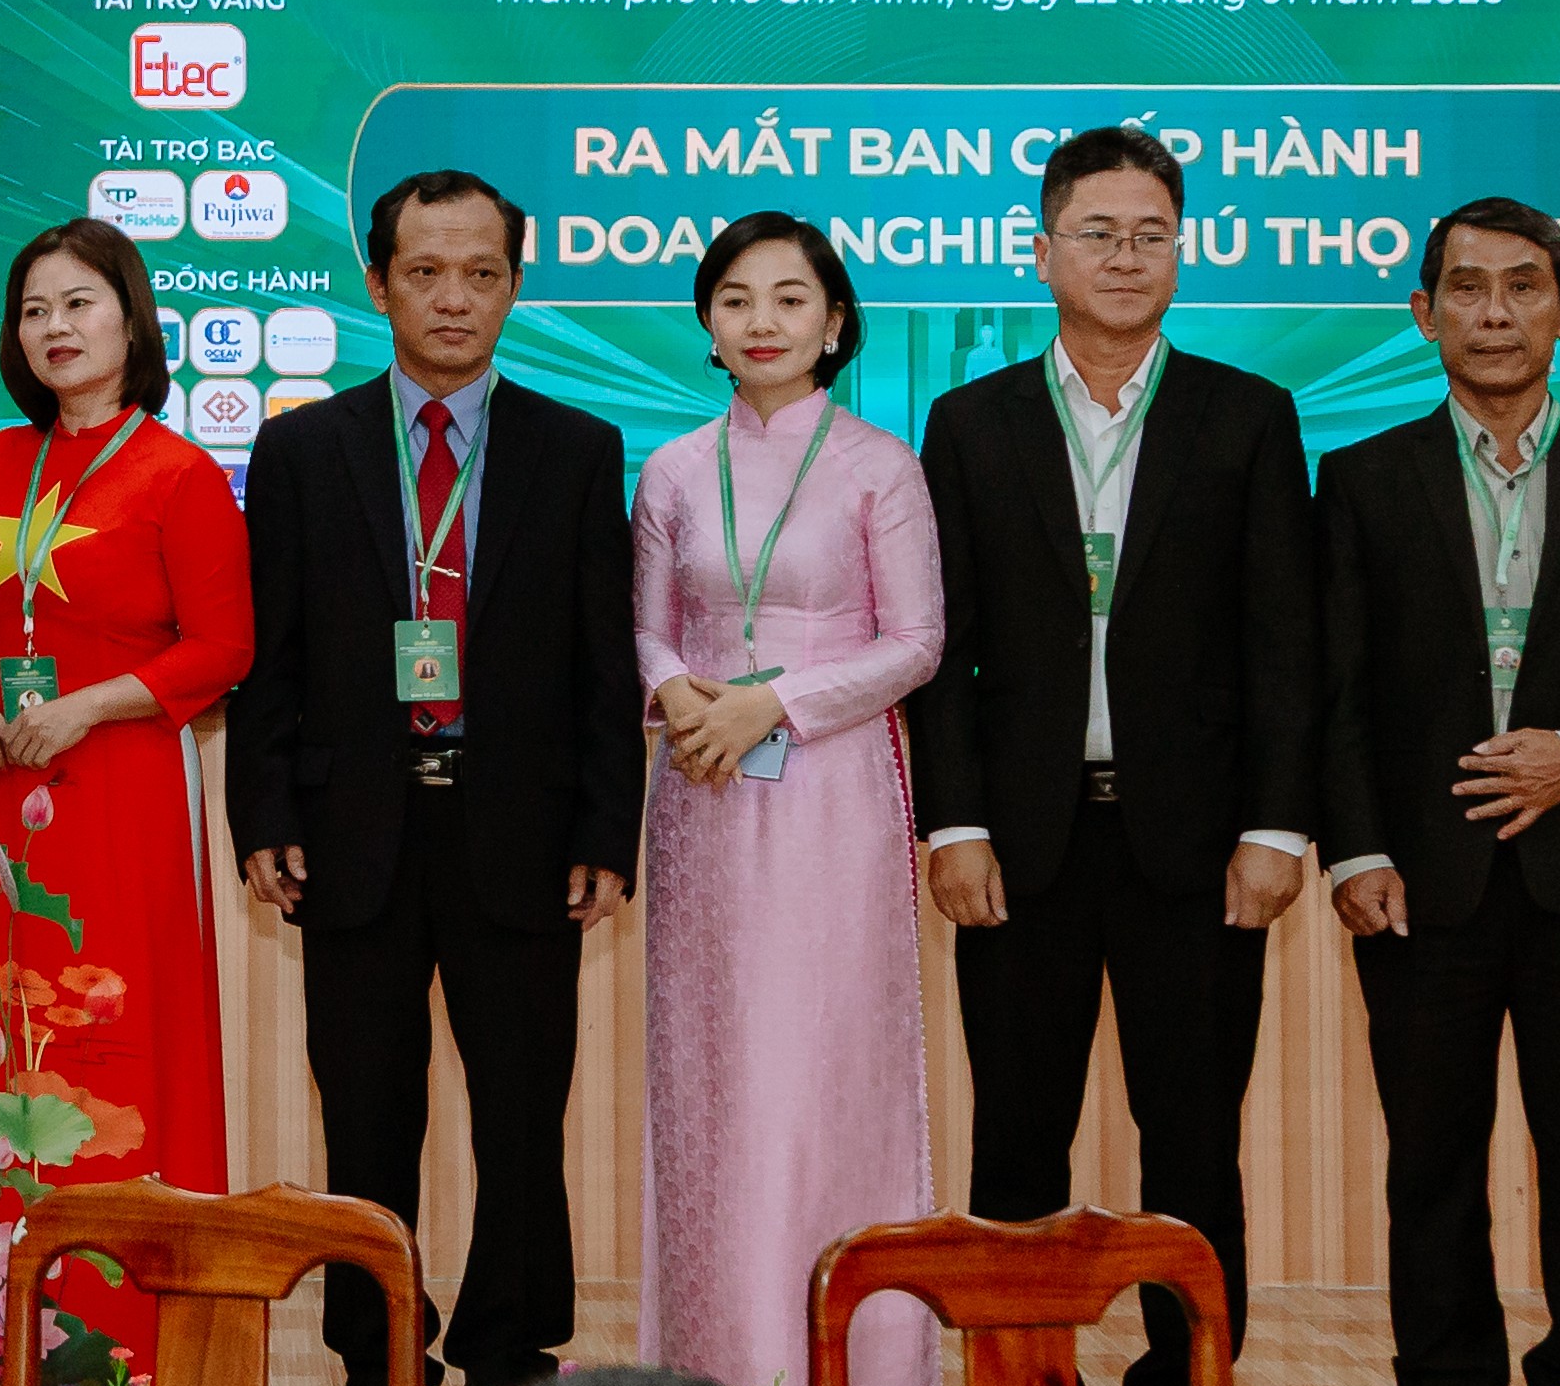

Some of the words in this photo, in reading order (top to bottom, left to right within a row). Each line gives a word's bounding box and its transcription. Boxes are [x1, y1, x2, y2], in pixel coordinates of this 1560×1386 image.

[99, 136, 143, 161] TÀI
[150, 138, 209, 166] TRỢ
[217, 139, 276, 166] BẠC
[575, 127, 667, 176] RA
[685, 106, 832, 176] MẮT
[849, 127, 992, 176] BAN
[1222, 115, 1420, 177] HÀNH
[203, 202, 275, 227] Fujiwa
[1264, 217, 1411, 279] THỌ
[153, 266, 239, 294] ĐỒNG
[248, 266, 330, 293] HÀNH
